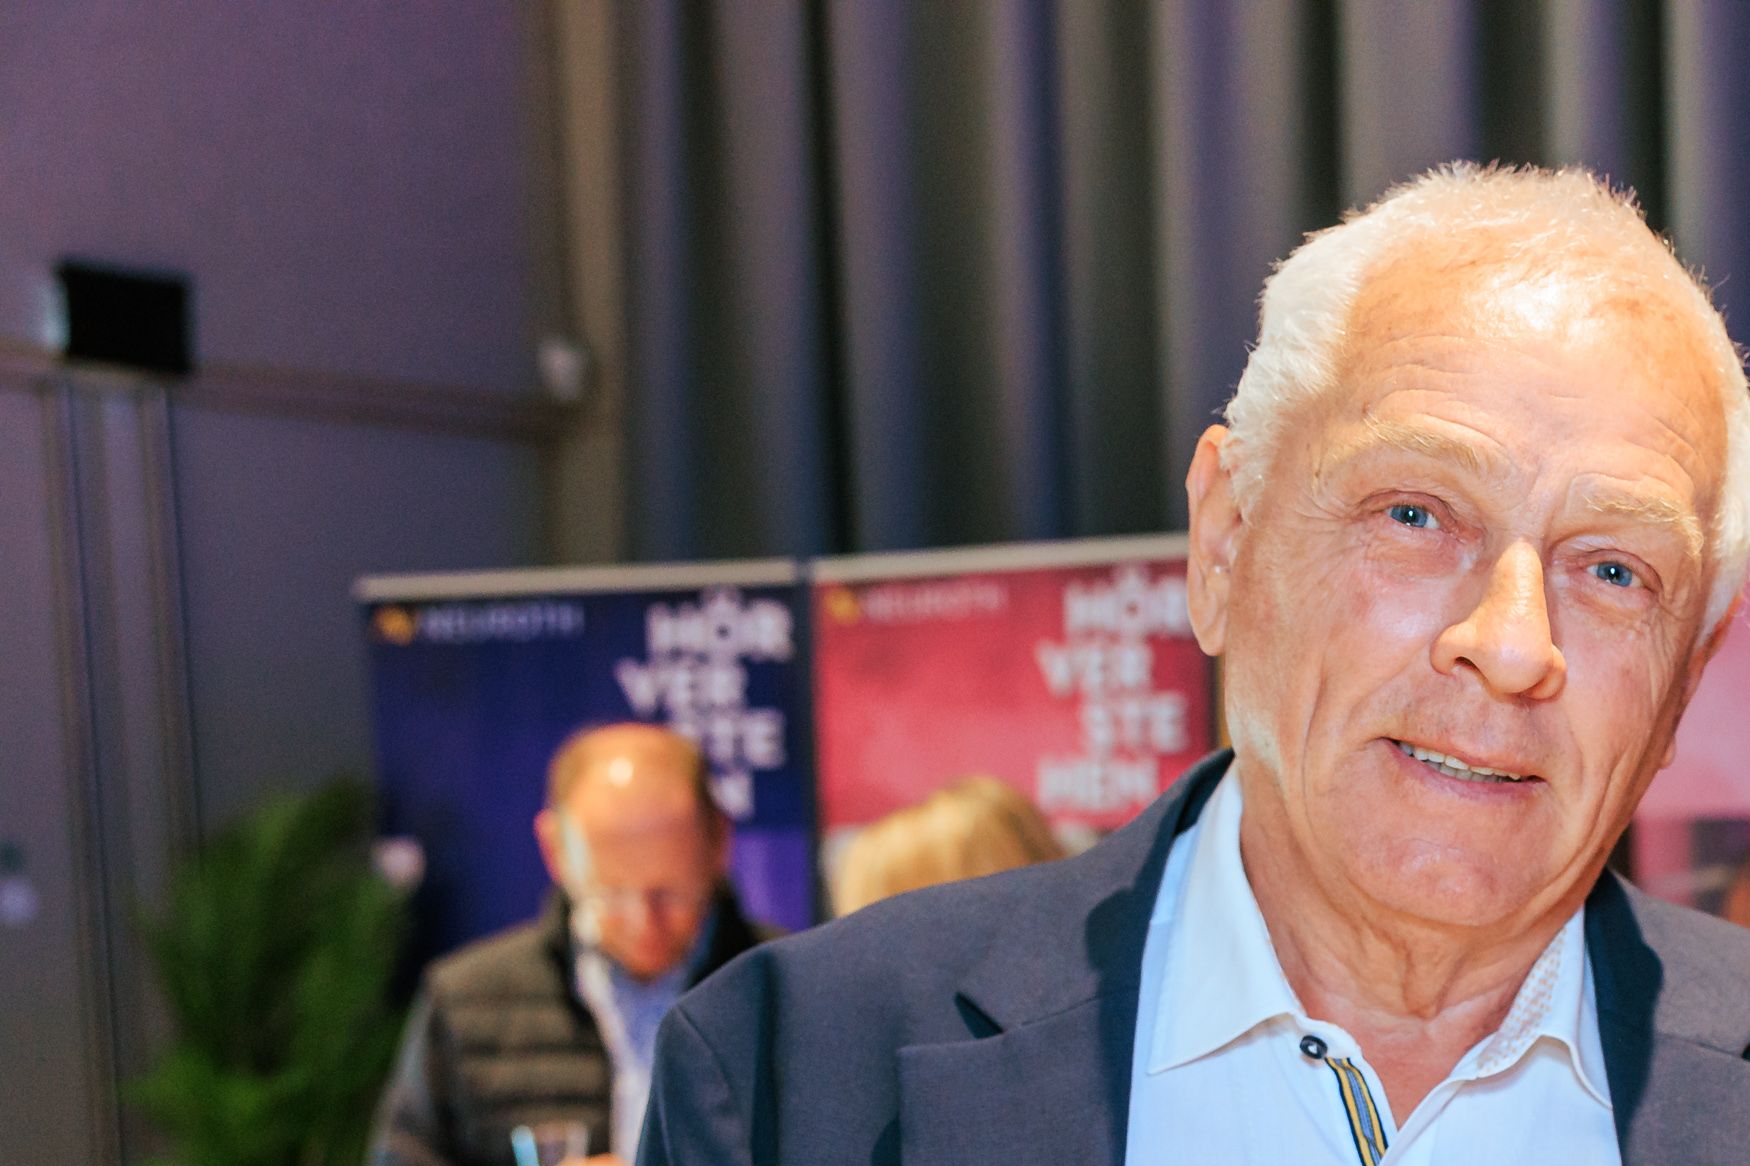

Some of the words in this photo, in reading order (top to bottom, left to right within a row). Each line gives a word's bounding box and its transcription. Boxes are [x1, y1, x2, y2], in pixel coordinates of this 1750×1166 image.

[1062, 565, 1188, 636] HÖR
[1036, 638, 1155, 697] VER
[1082, 692, 1188, 756] STE
